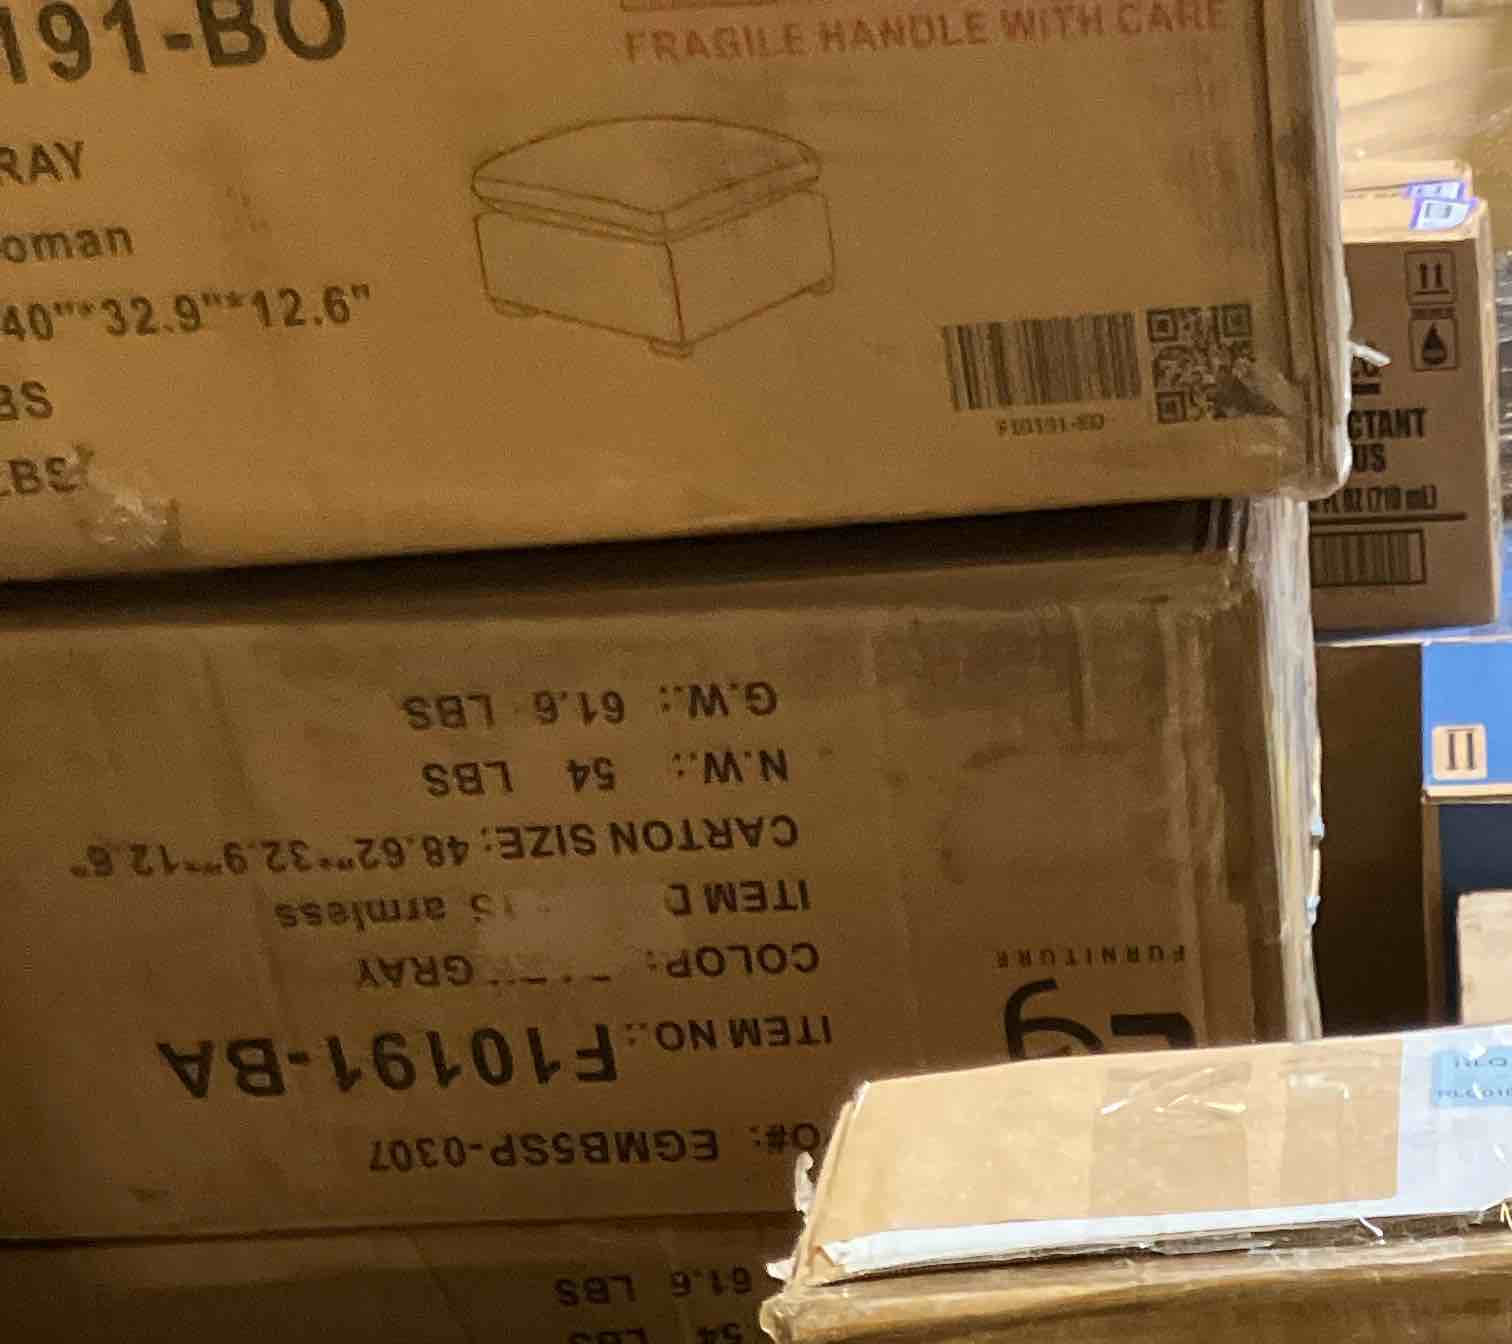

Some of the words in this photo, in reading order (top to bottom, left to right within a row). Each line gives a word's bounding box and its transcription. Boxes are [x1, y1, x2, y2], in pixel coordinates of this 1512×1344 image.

[624, 26, 807, 64] FRAGILE
[820, 10, 989, 54] HANDLE
[1001, 4, 1101, 40] WITH
[1112, 0, 1229, 34] CARE
[402, 693, 495, 730] LBS
[534, 691, 624, 725] 61.6
[660, 681, 777, 718] G.W.:
[422, 761, 513, 797] LBS
[567, 757, 615, 792] 54
[674, 749, 788, 784] N.W.:
[481, 823, 596, 859] SIZE:
[609, 815, 798, 855] CARTON
[275, 896, 446, 932] armless
[704, 880, 810, 914] ITEM
[357, 955, 474, 988] GRAY
[997, 944, 1185, 968] FURNITURE
[728, 1016, 831, 1048] ITEM
[157, 1024, 617, 1098] F10191-BA
[369, 1129, 718, 1172] EGMB5SP-0307
[554, 1275, 635, 1306] LBS
[668, 1267, 752, 1298] 61.6
